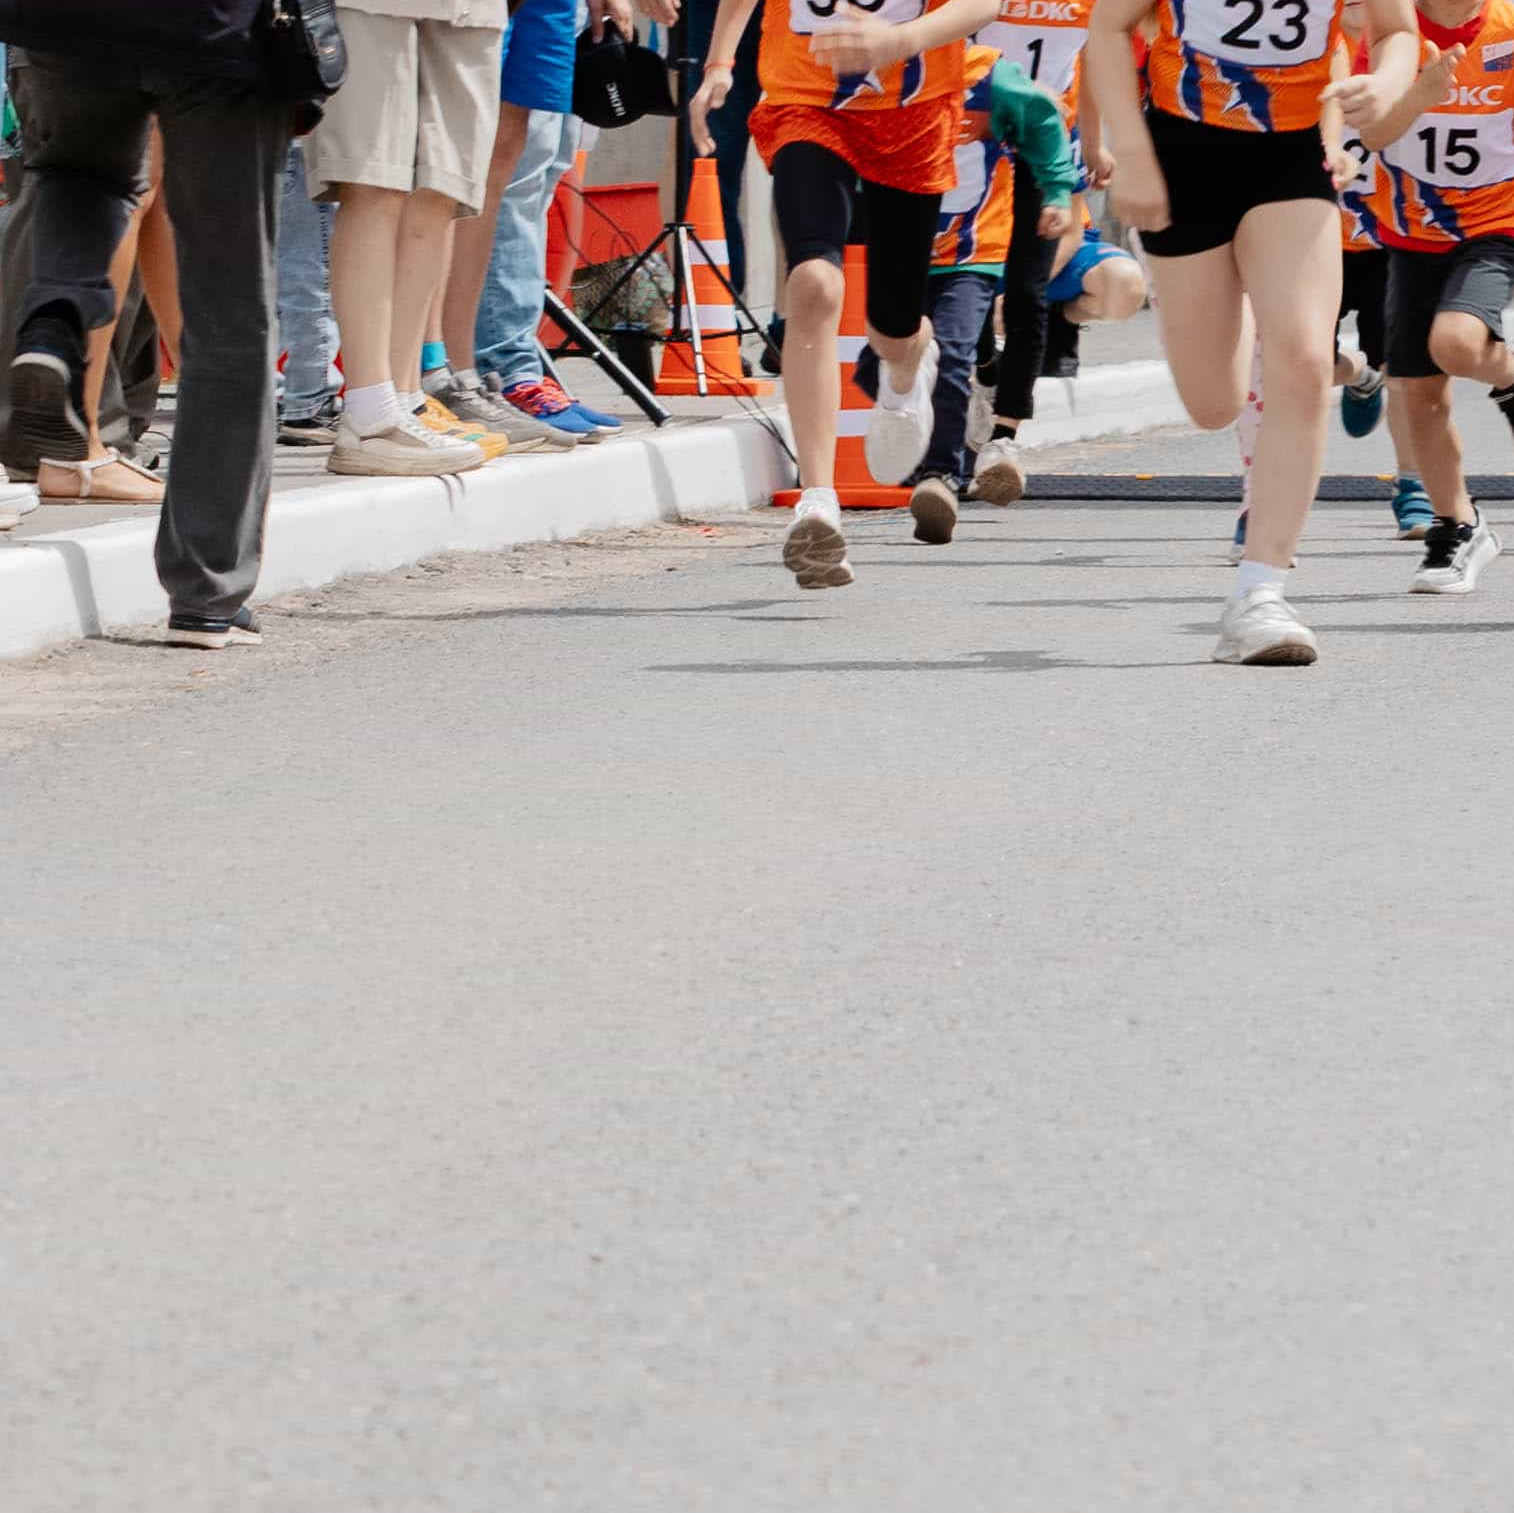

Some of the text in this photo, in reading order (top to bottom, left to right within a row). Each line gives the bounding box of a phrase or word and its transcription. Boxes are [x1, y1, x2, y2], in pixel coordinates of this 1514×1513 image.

[1028, 0, 1082, 22] DKC
[1026, 38, 1044, 81] 1
[1416, 126, 1481, 176] 15
